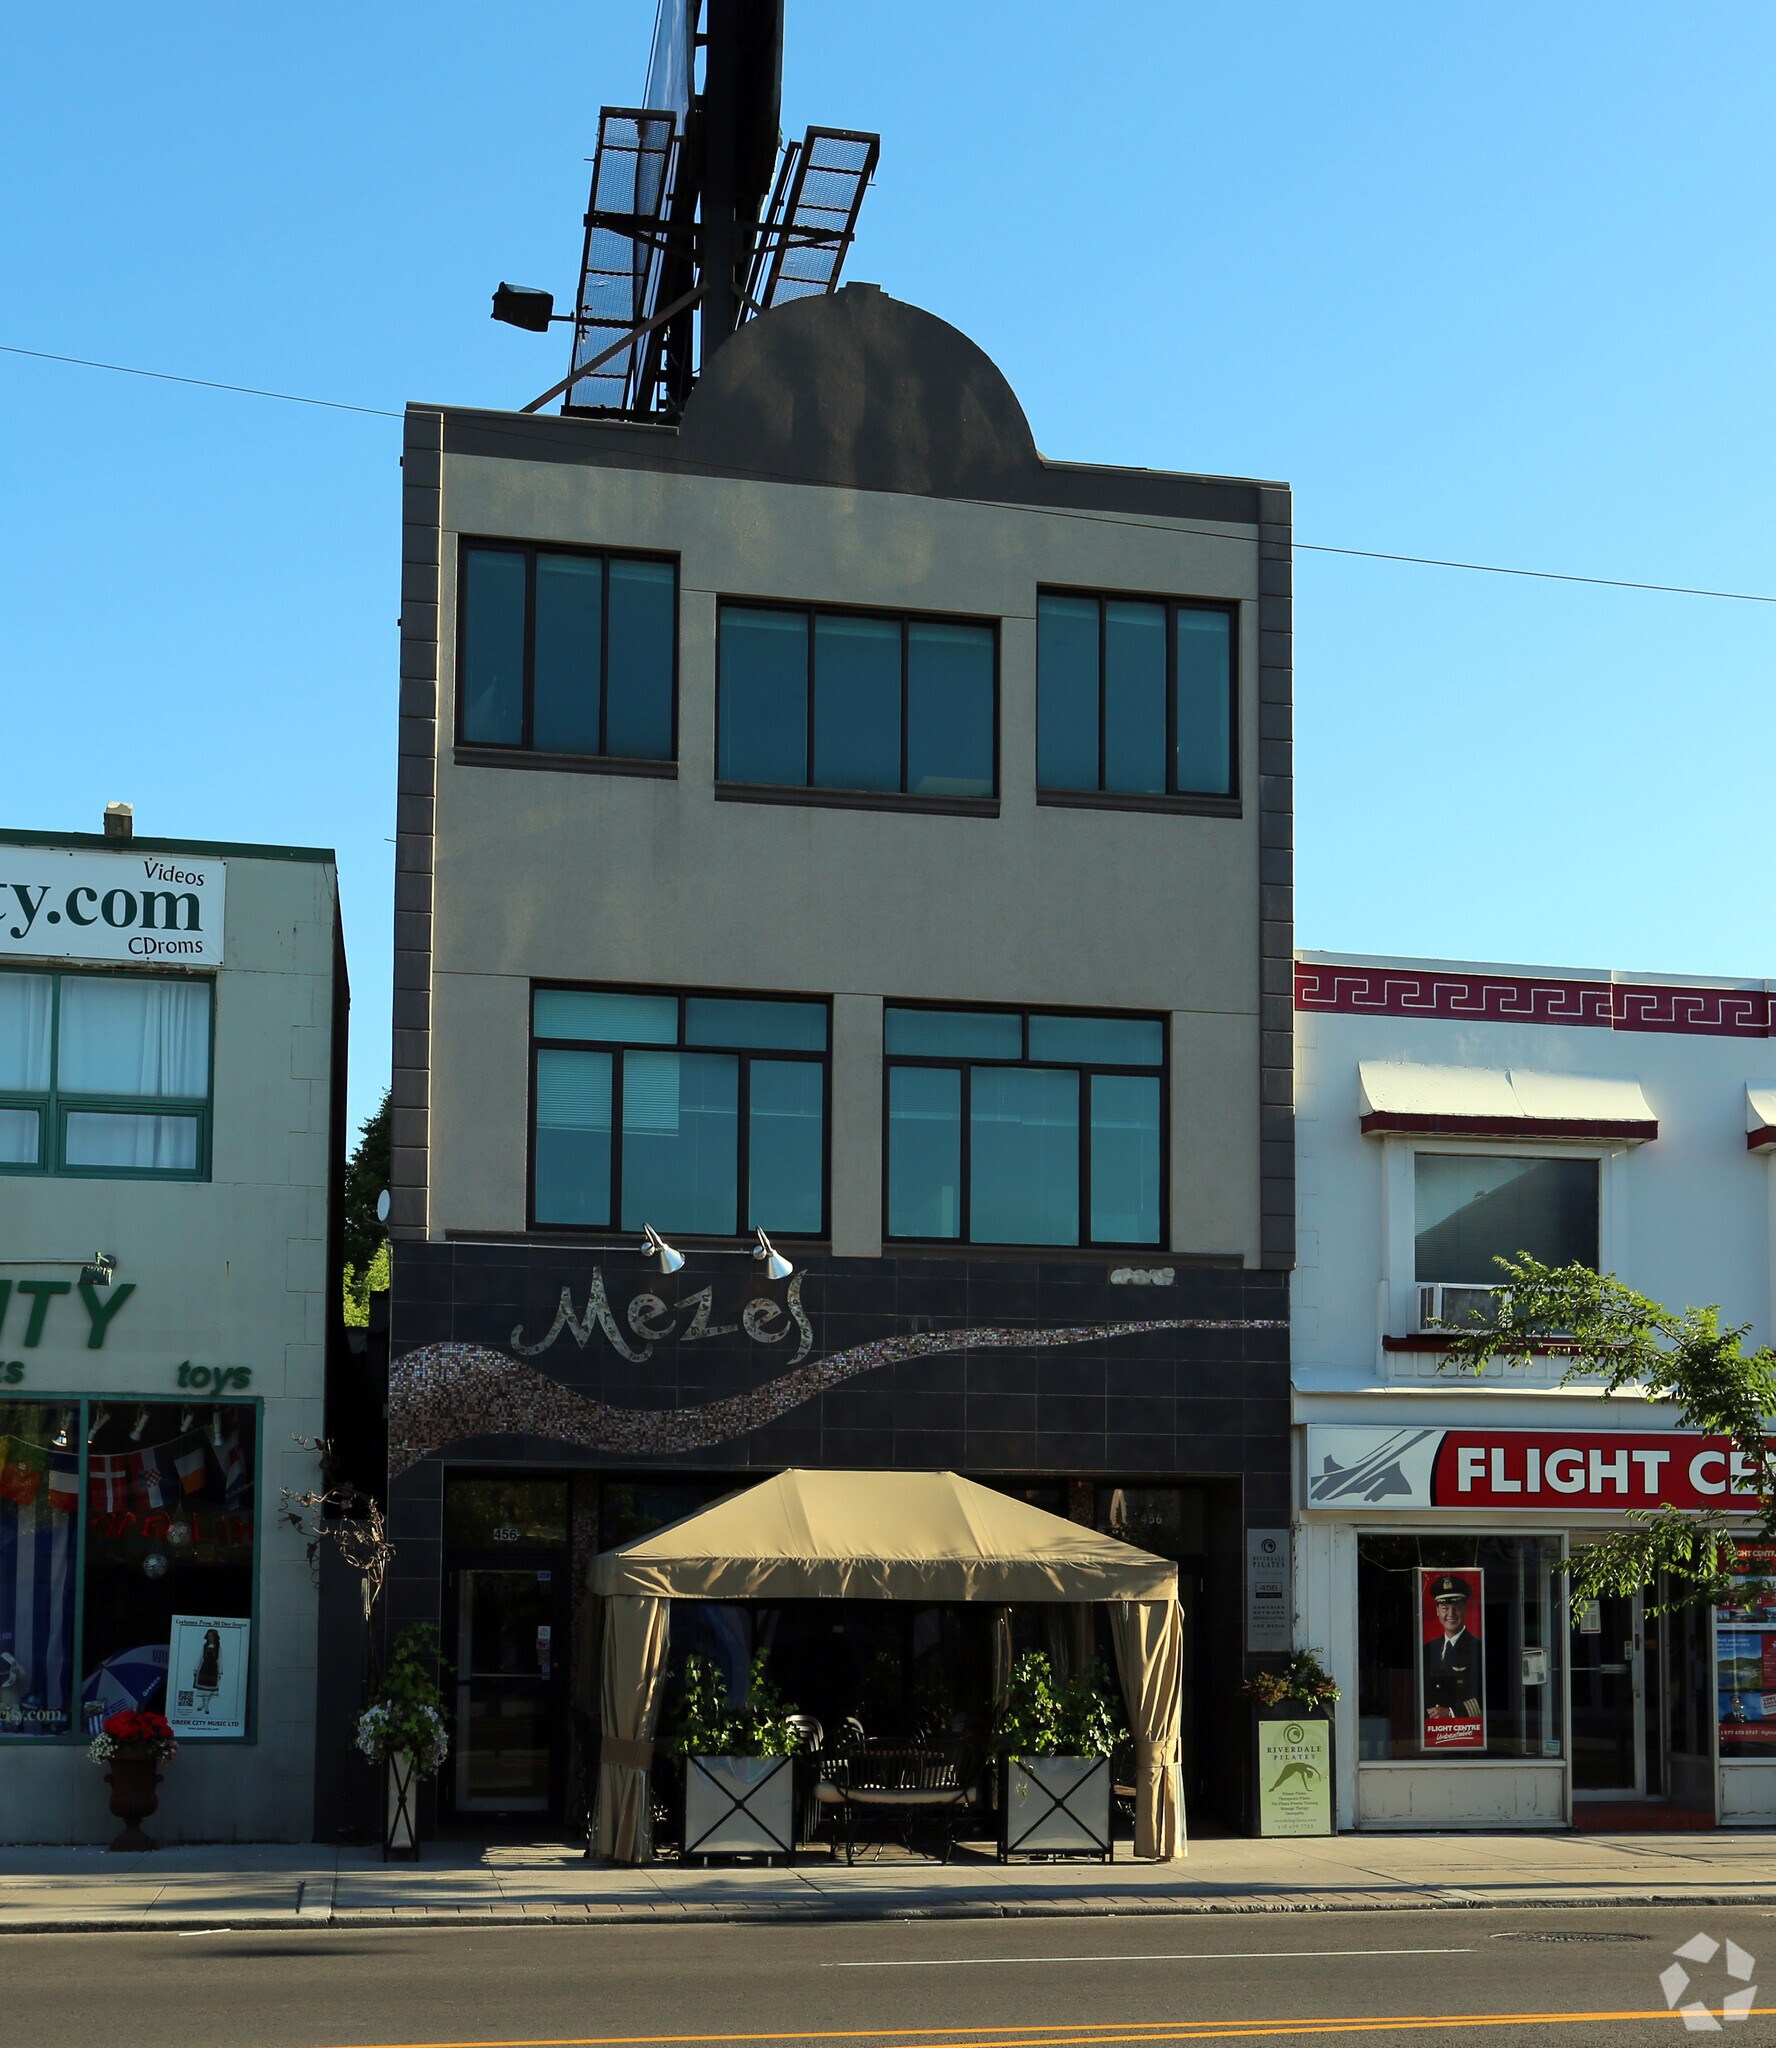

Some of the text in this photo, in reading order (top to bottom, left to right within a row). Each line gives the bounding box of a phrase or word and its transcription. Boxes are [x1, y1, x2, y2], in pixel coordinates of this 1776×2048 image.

[144, 861, 205, 886] Videos
[128, 937, 203, 955] CDroms
[510, 1265, 814, 1365] Mezes
[177, 1360, 253, 1396] toys
[1456, 1446, 1671, 1495] FLIGHT
[494, 1528, 518, 1541] 456
[1267, 1745, 1322, 1753] RIVERDALE
